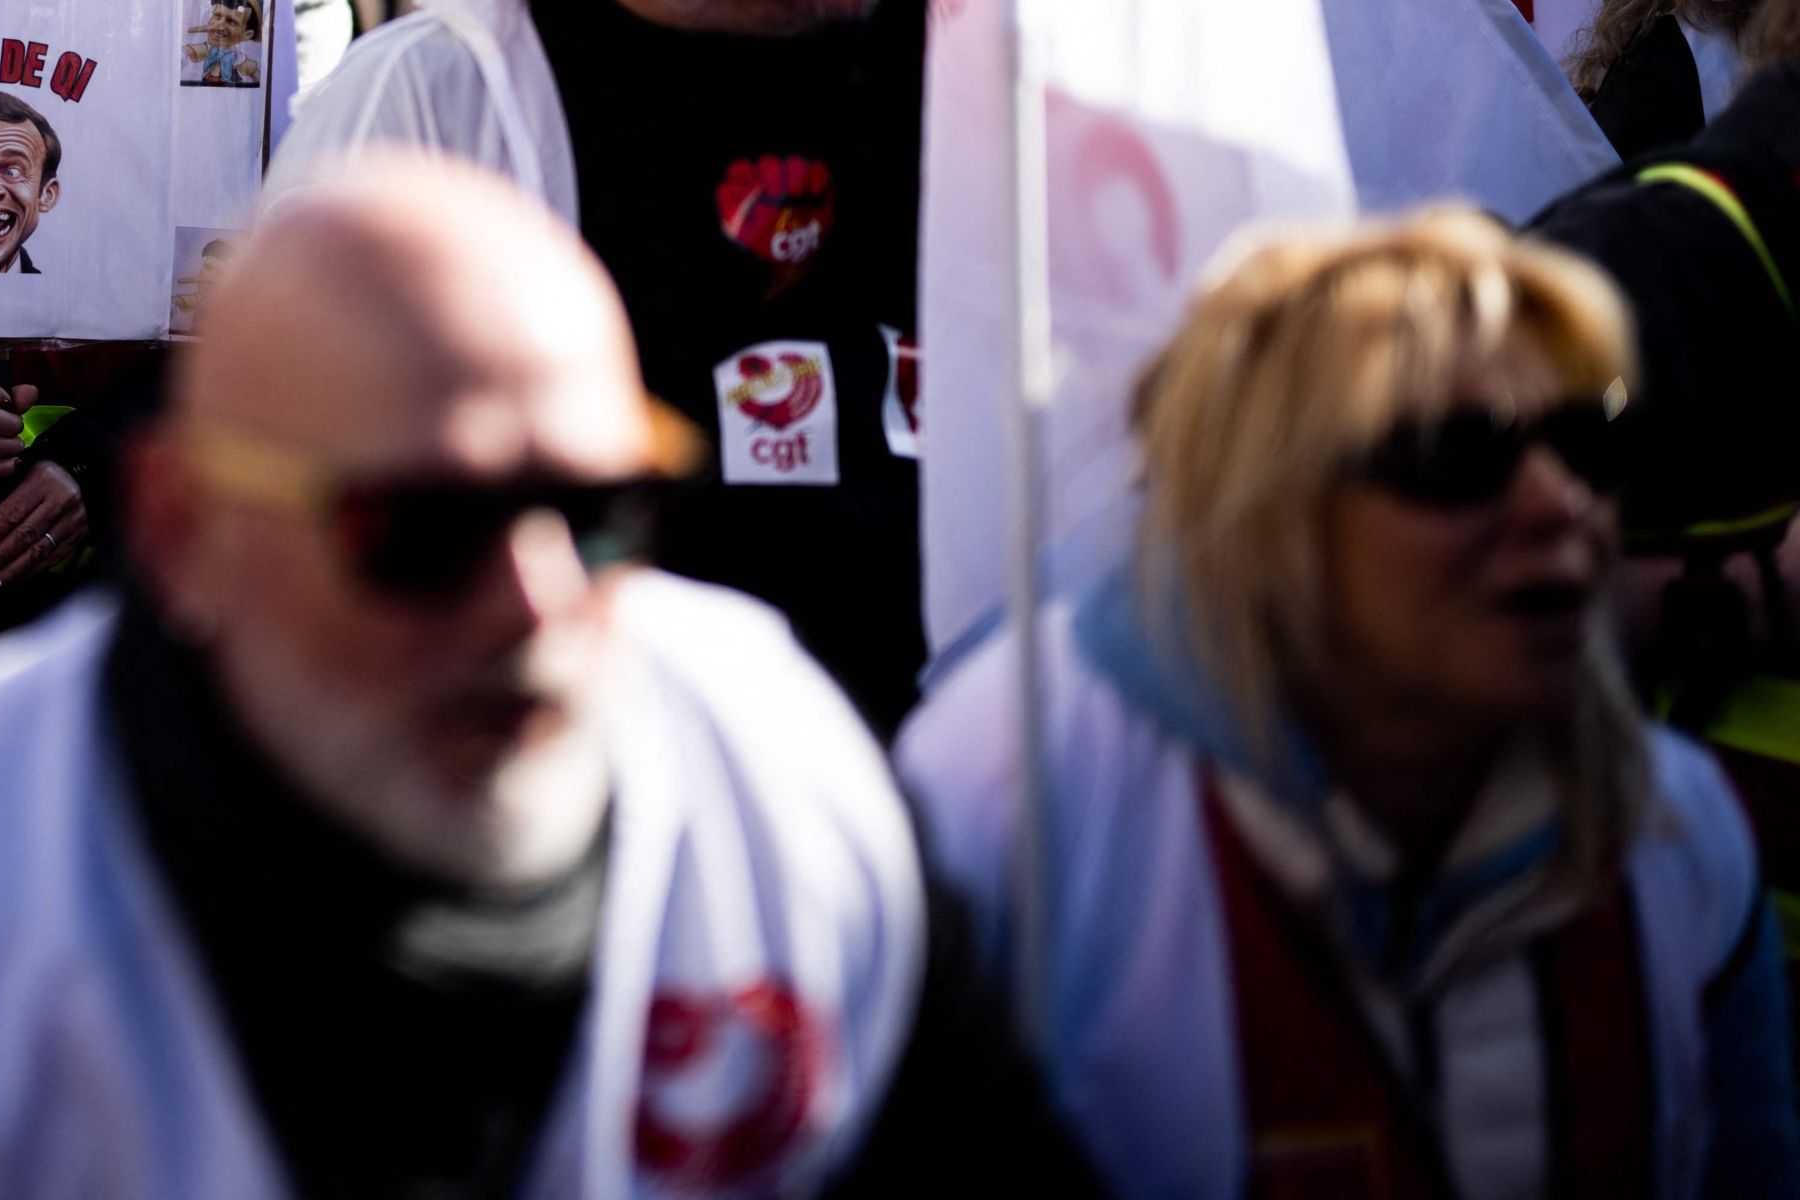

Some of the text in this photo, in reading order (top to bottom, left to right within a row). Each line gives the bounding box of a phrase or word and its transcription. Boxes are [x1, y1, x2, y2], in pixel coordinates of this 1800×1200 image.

[50, 51, 98, 103] QI
[770, 218, 821, 262] cgt
[750, 433, 809, 473] cgt
